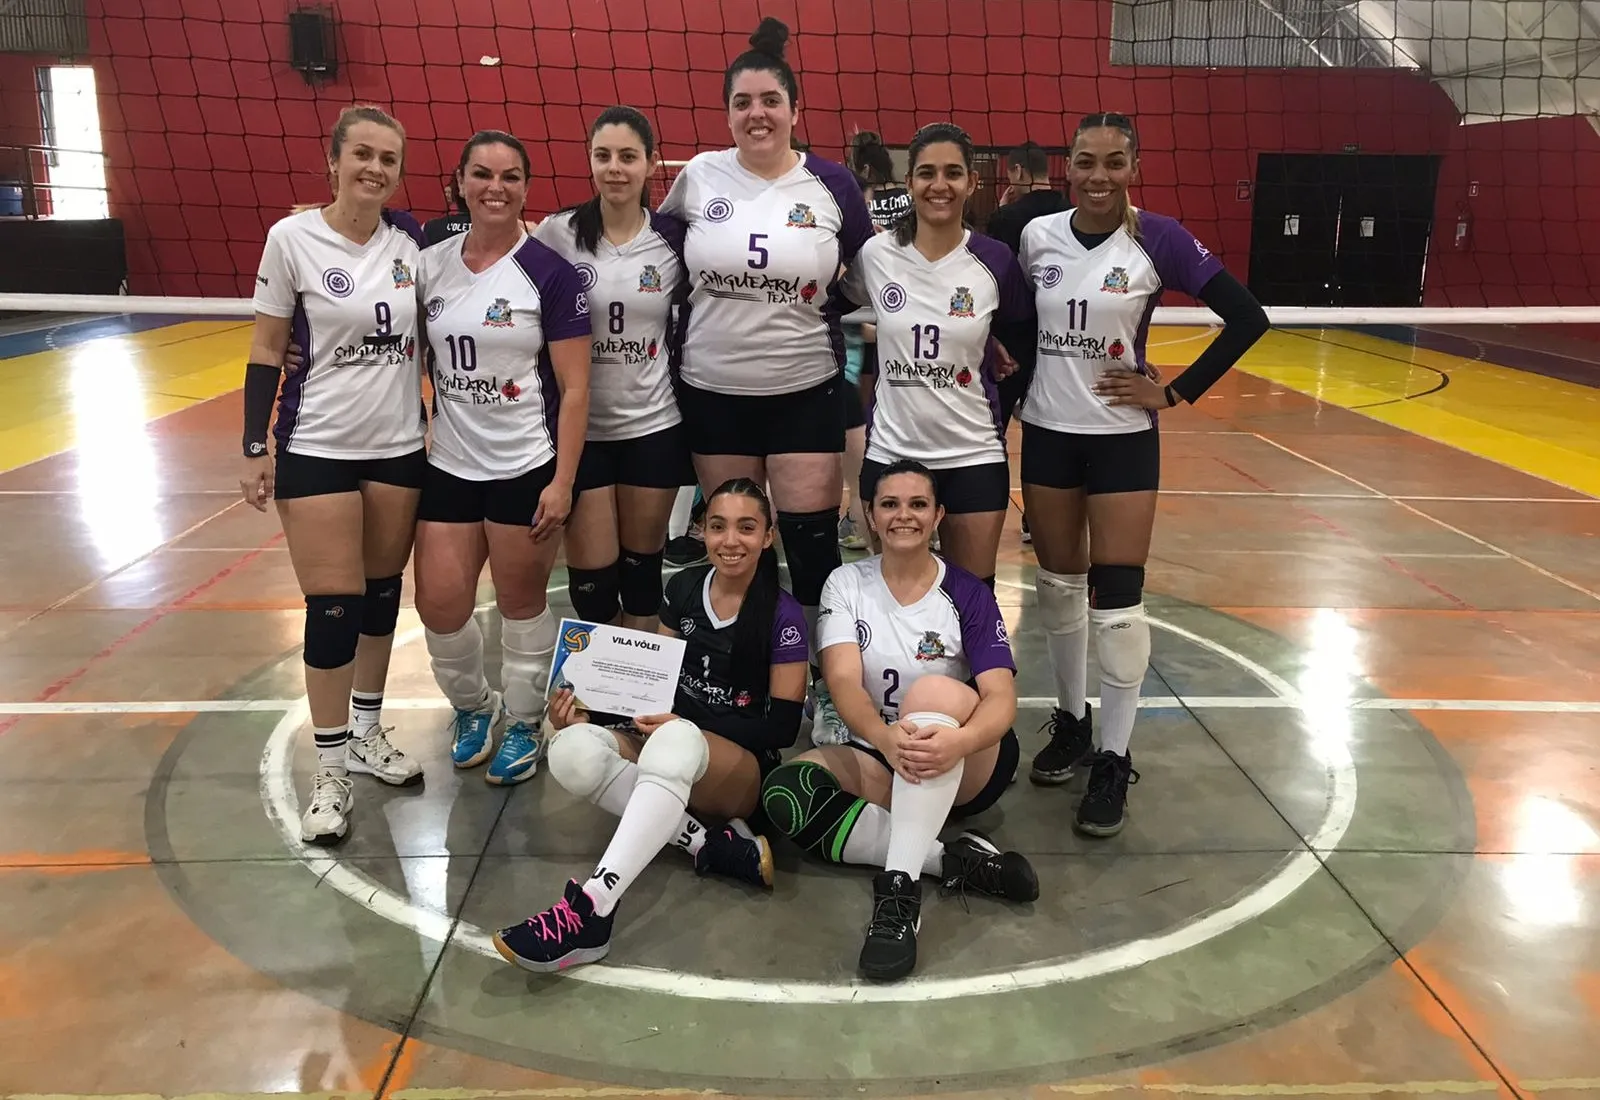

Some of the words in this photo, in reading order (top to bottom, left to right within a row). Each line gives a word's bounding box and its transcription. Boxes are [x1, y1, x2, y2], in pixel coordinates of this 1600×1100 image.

[747, 233, 769, 270] 5
[767, 291, 799, 306] TEAM
[1066, 298, 1088, 331] 11
[374, 301, 392, 338] 9
[608, 301, 625, 335] 8
[444, 333, 477, 372] 10
[591, 336, 646, 356] GUEARU
[911, 323, 940, 360] 13
[471, 392, 503, 406] TEAM
[612, 635, 633, 647] VILA
[701, 655, 711, 679] 1
[883, 668, 900, 709] 2
[677, 820, 701, 847] UE
